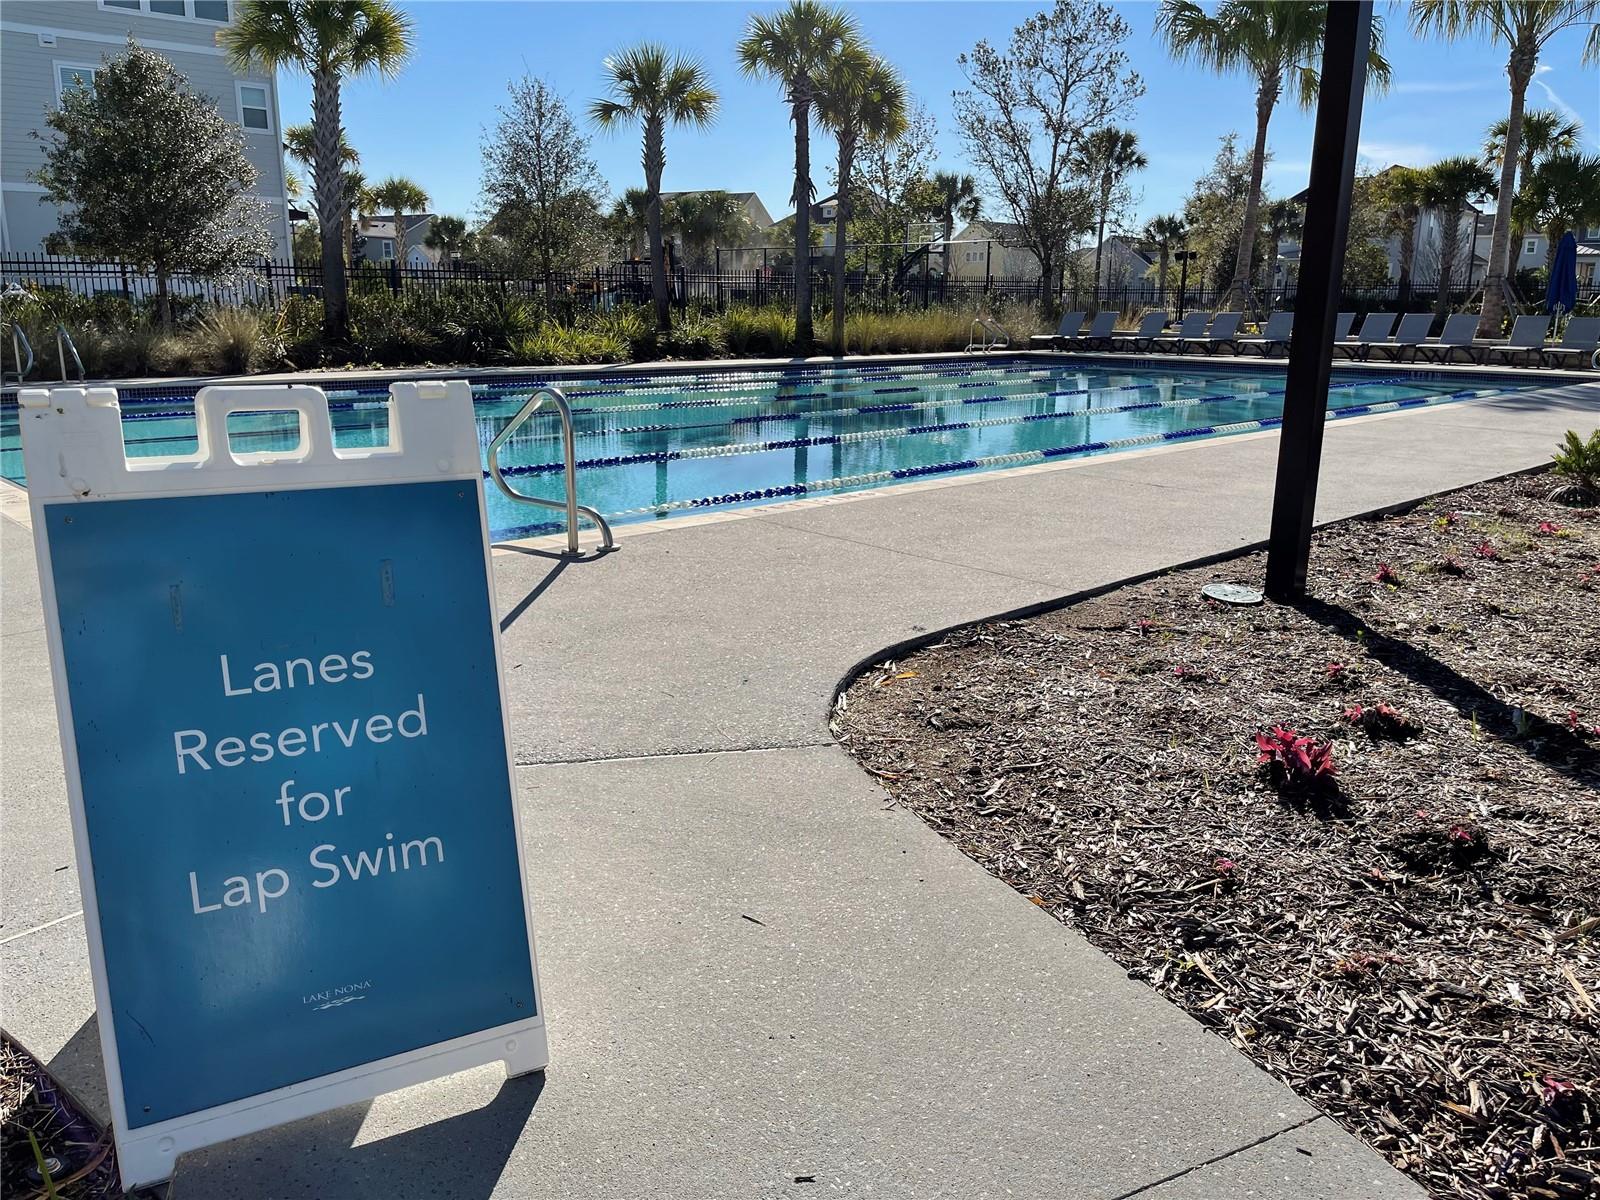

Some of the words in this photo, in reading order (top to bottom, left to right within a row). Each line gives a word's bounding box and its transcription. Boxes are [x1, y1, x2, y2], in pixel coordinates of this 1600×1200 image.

[221, 650, 375, 697] Lanes
[174, 694, 429, 774] Reserved
[276, 780, 351, 825] for
[190, 866, 290, 914] Lap
[309, 833, 444, 888] Swim
[303, 990, 329, 1003] LAKE
